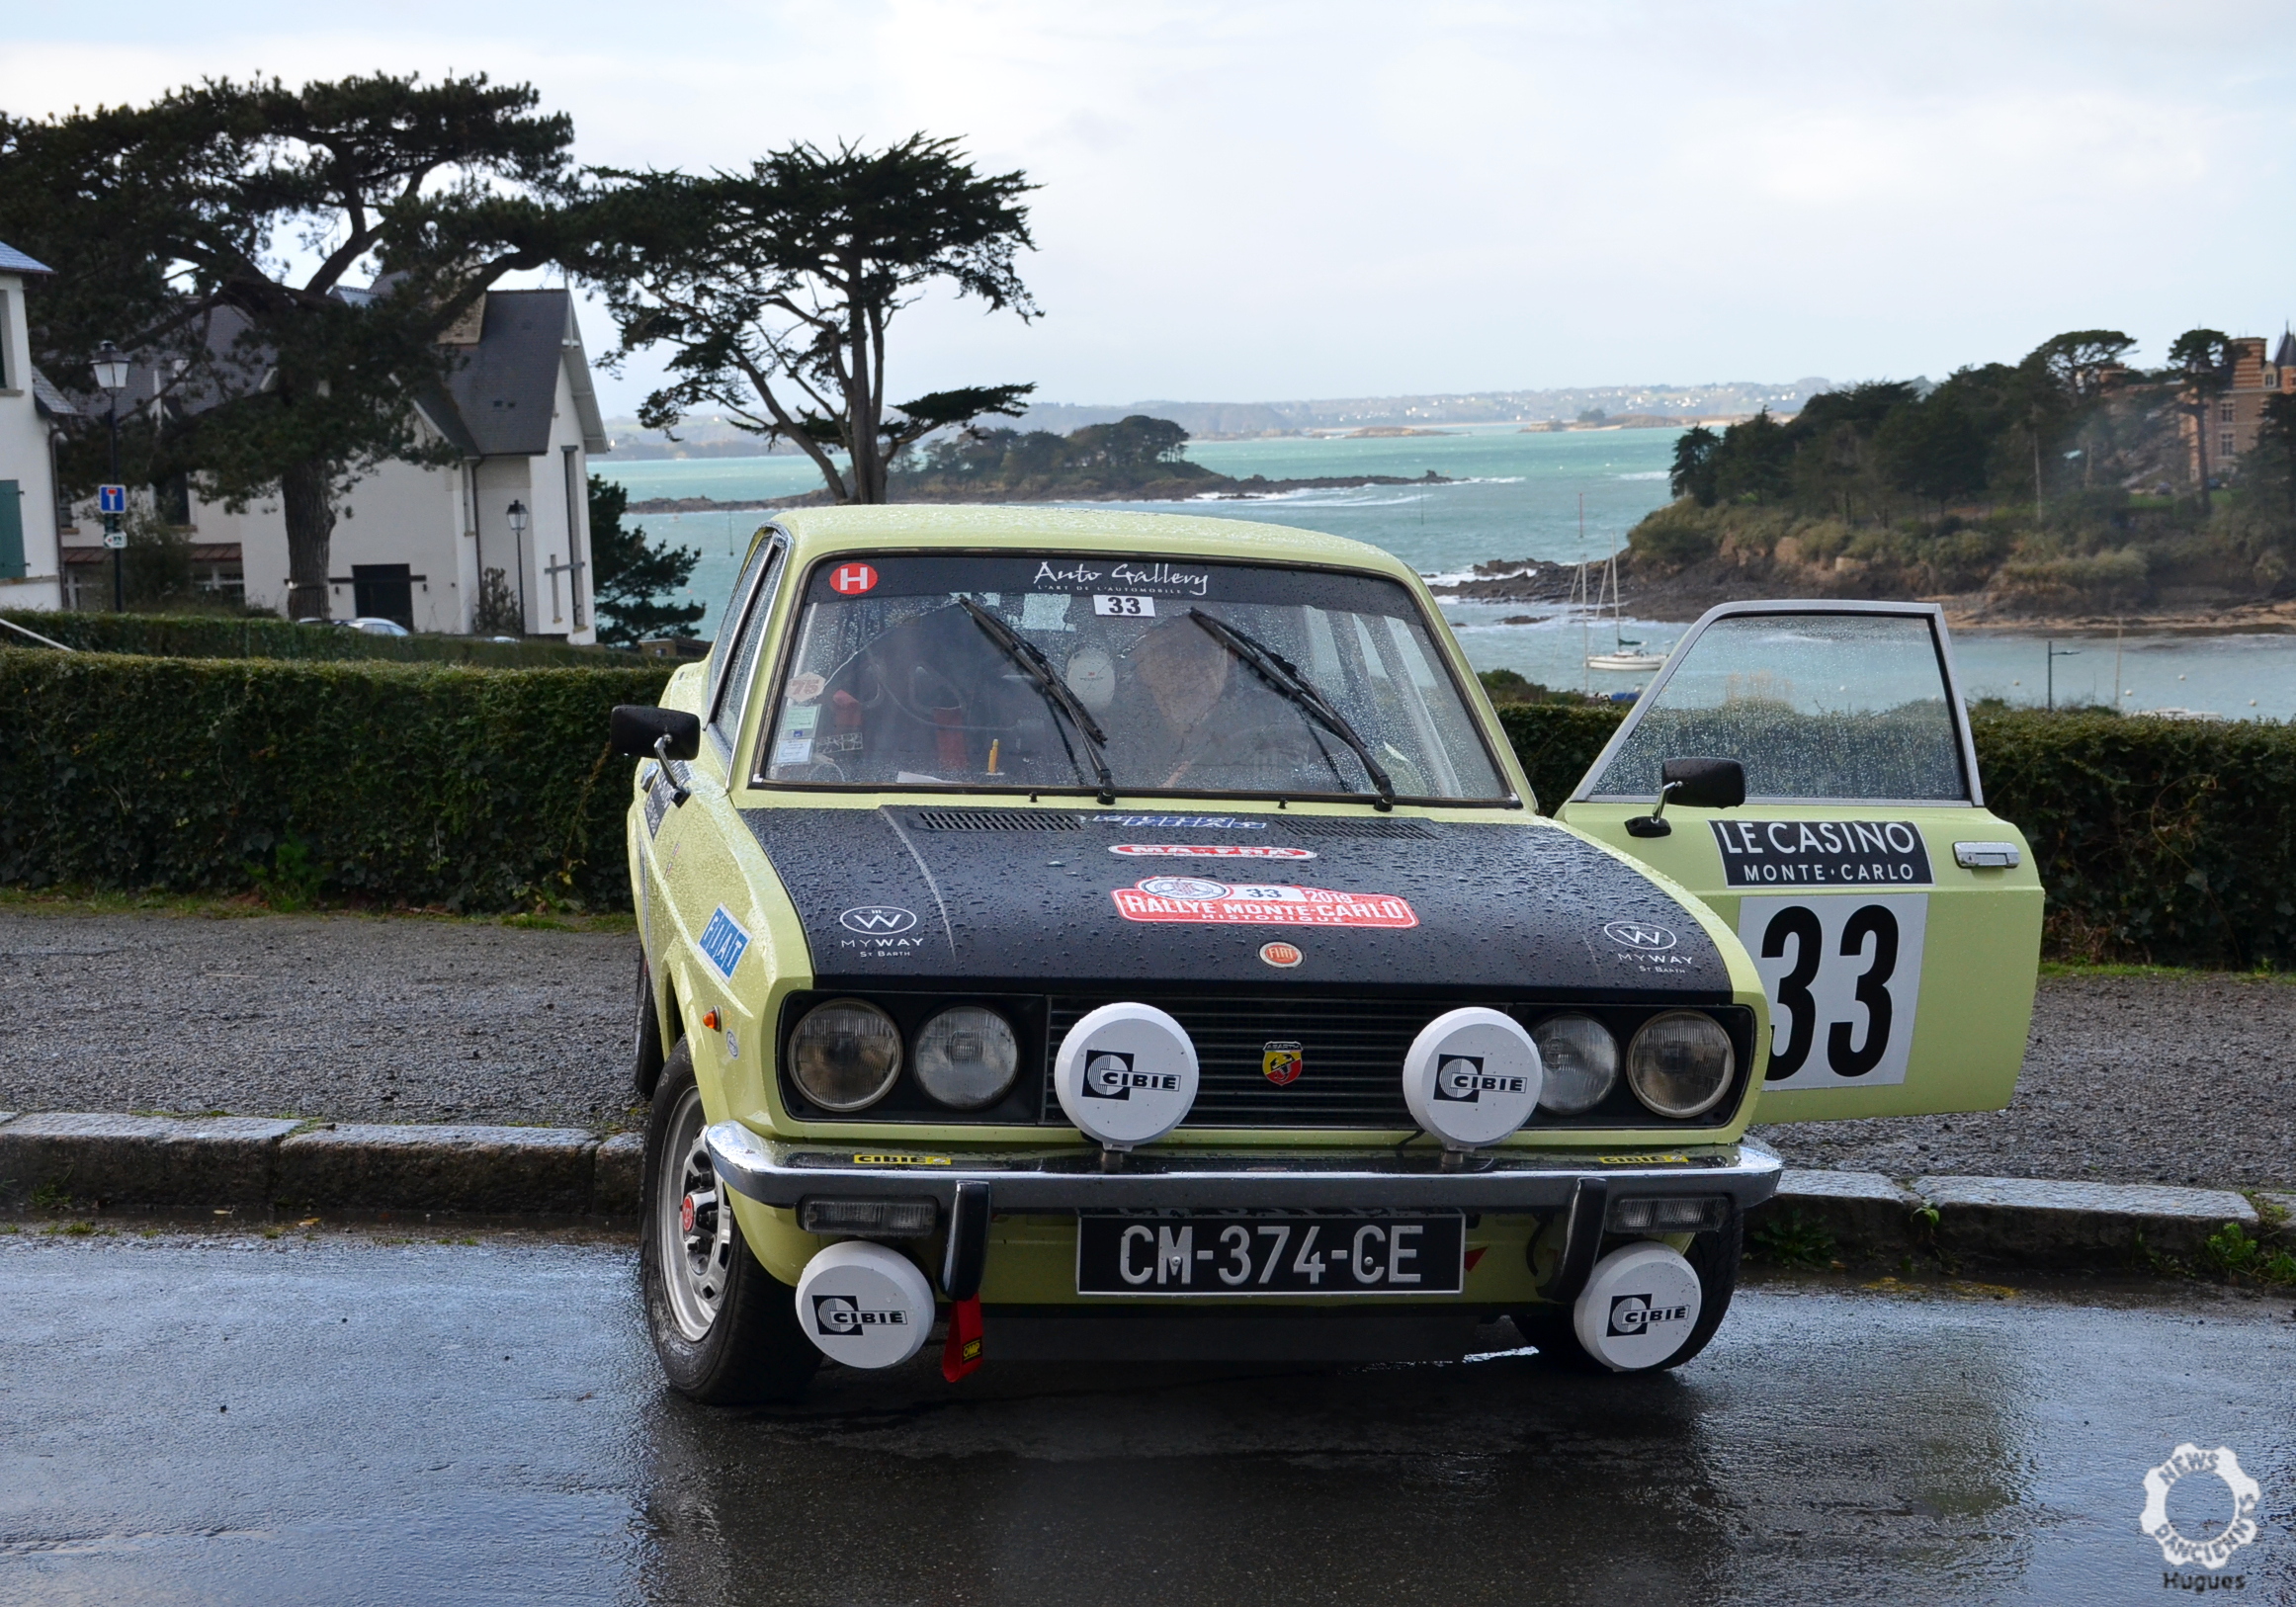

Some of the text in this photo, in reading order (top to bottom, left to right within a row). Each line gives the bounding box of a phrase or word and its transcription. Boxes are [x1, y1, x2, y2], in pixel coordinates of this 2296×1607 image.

[840, 567, 868, 590] H
[1034, 561, 1208, 595] Auto Gallery
[1107, 596, 1141, 615] 33
[1717, 822, 1914, 854] LE CASINO
[1246, 888, 1283, 898] 33
[1306, 890, 1353, 904] 2019
[1126, 894, 1405, 919] RALLYE MONTE-CARLO
[1201, 912, 1342, 923] HISTORIQUE
[703, 915, 743, 969] FIAT
[1268, 947, 1295, 959] FIAT
[1761, 904, 1900, 1082] 33
[1120, 1225, 1423, 1285] CM-374-CE
[963, 1342, 980, 1358] OMP
